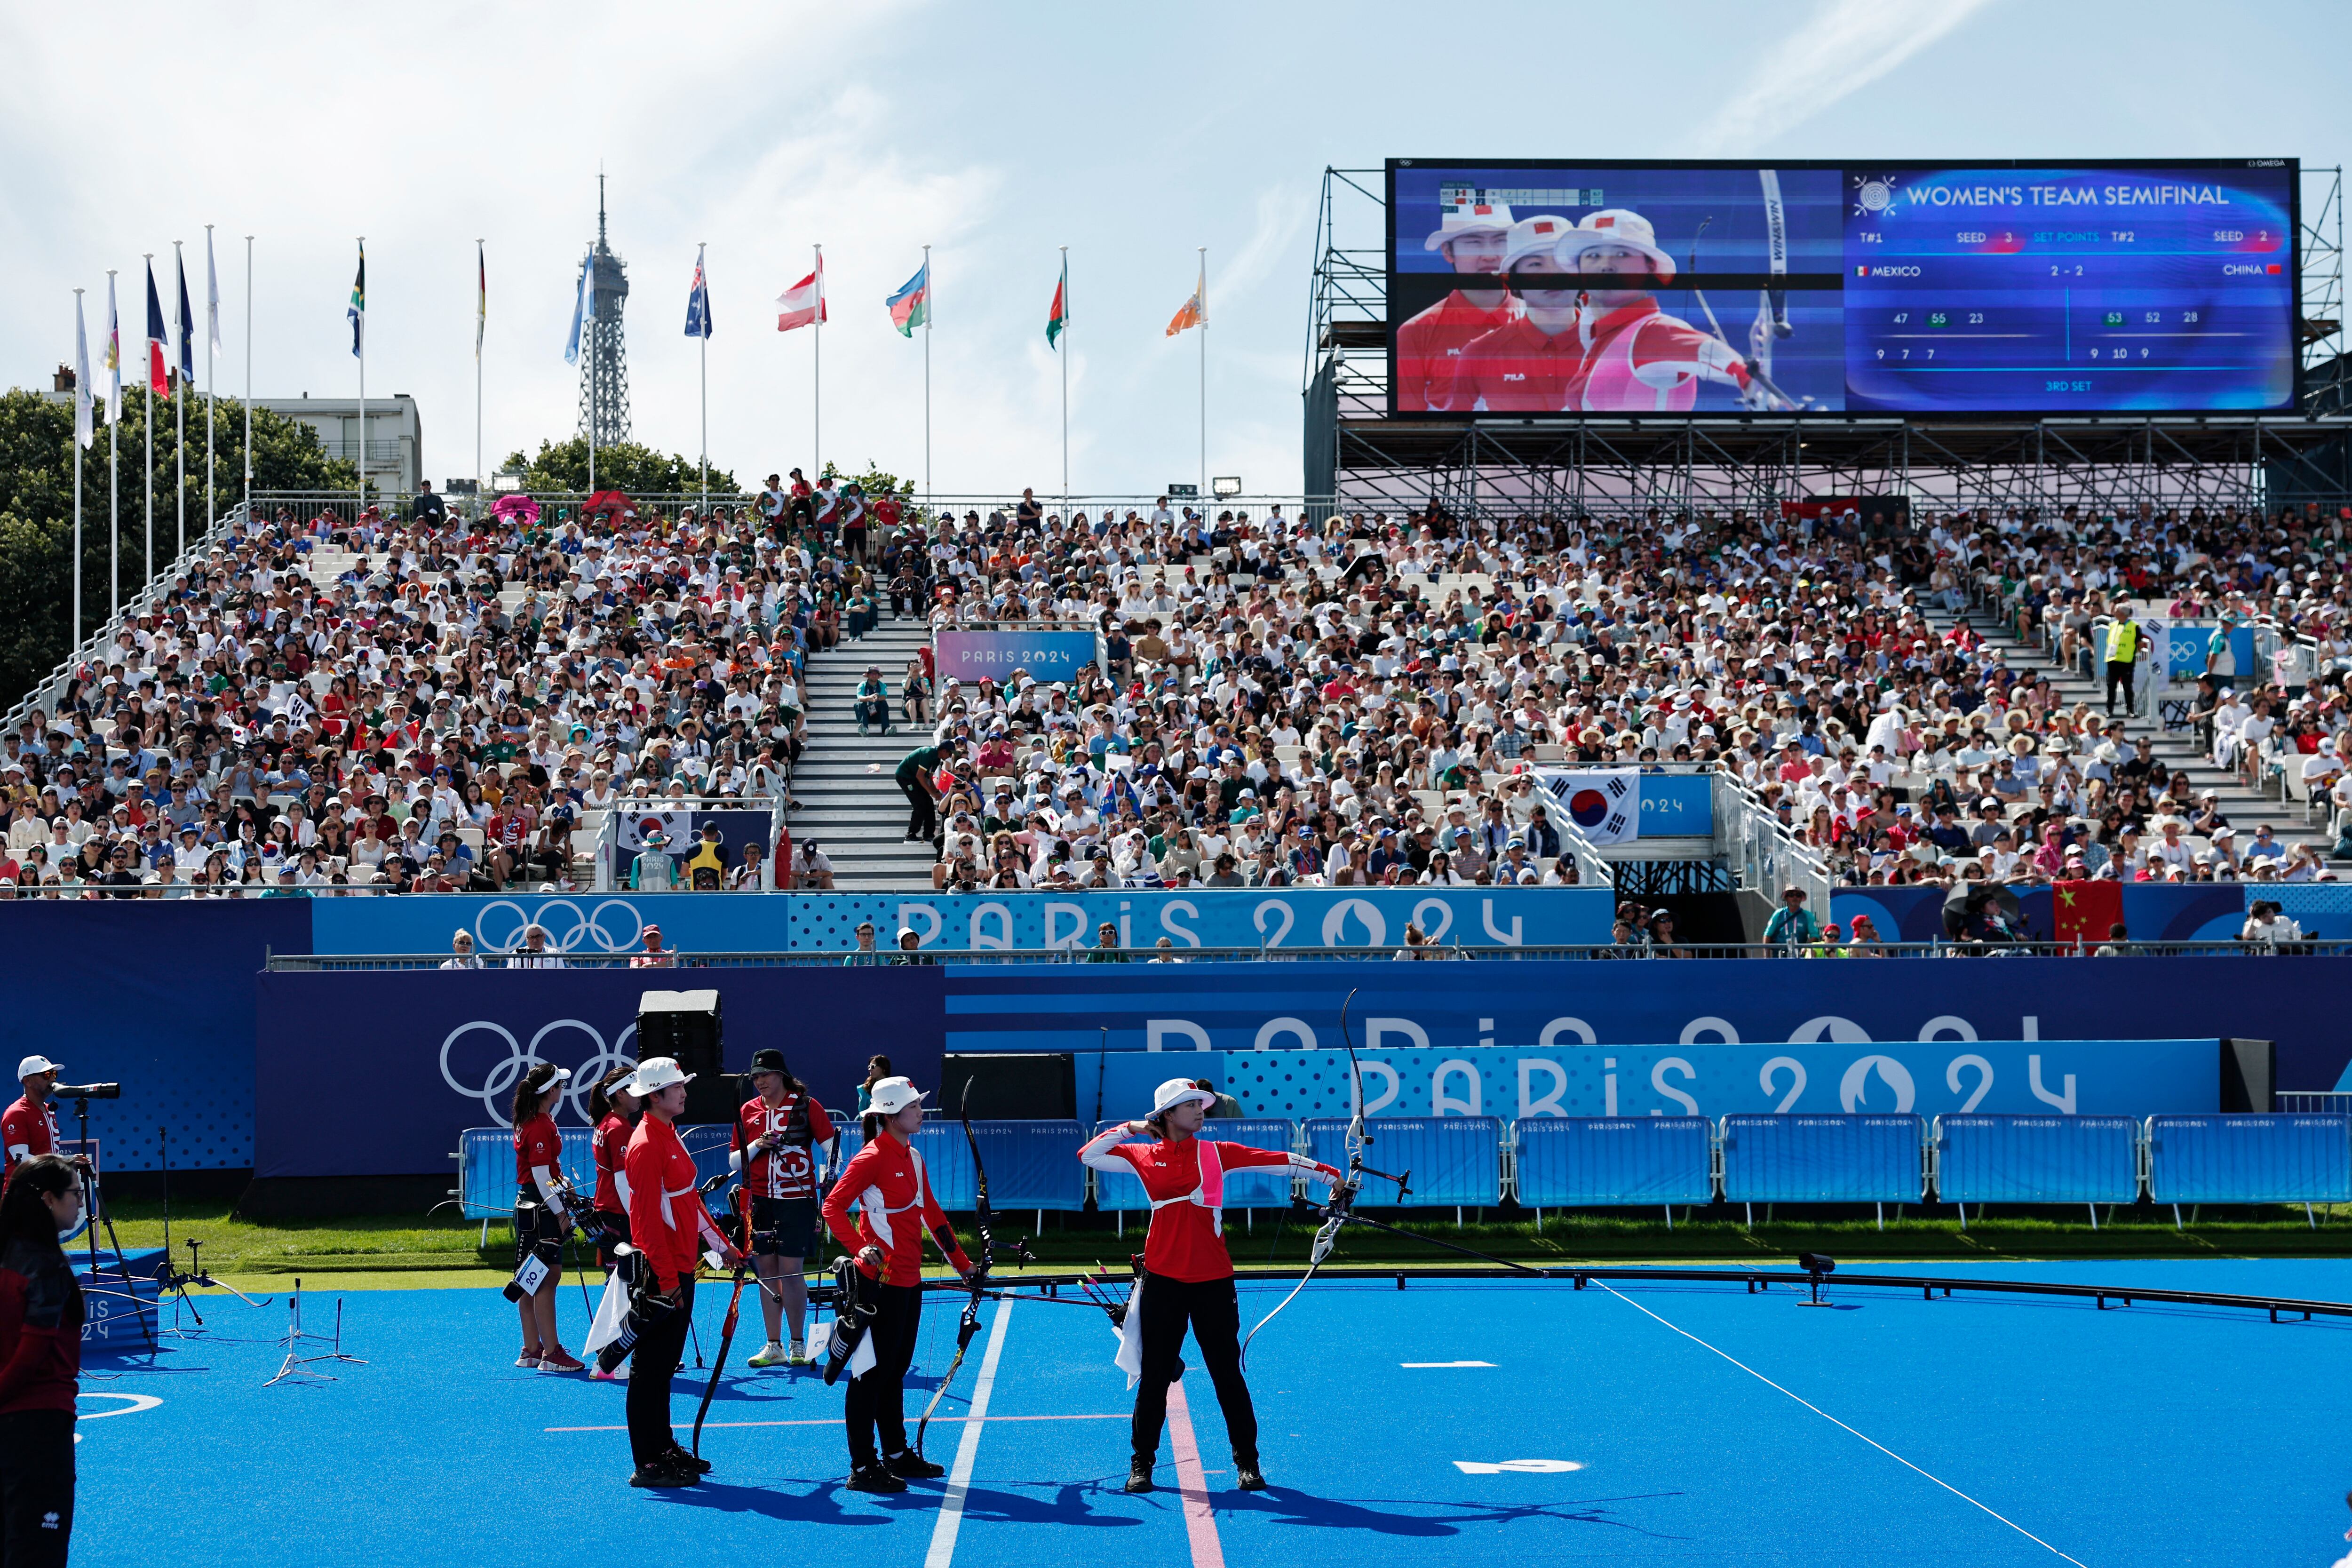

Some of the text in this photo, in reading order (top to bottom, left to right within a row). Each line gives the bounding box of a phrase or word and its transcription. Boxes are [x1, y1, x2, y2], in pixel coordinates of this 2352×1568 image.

[1907, 185, 2229, 206] WOMEN'S TEAM SEMIFINAL
[1769, 199, 1783, 261] WIN&WIN
[1860, 232, 1883, 243] T#1
[1956, 232, 2012, 243] SEED 3
[2033, 231, 2100, 242] SET POINTS
[2112, 231, 2135, 242] T#2
[2214, 231, 2268, 242] SEED 2
[1871, 266, 1921, 278] MEXICO
[2051, 266, 2058, 277] 2
[2075, 265, 2083, 277] 2
[2223, 264, 2263, 276] CHINA
[1894, 313, 1908, 324] 47
[1932, 313, 1946, 324] 55
[1969, 312, 1984, 324] 23
[2108, 312, 2122, 323] 53
[2146, 312, 2160, 323] 52
[2183, 312, 2198, 323] 28
[1876, 349, 1885, 359] 9
[1902, 349, 1909, 359] 7
[1927, 349, 1934, 359] 7
[2090, 348, 2098, 359] 9
[2113, 348, 2127, 359] 10
[2140, 348, 2149, 358] 9
[2046, 382, 2092, 392] 3RD SET
[1022, 651, 1069, 662] 2024
[1641, 799, 1683, 812] 024
[1253, 898, 1522, 947] 2024
[1760, 1055, 2074, 1115] 2024
[526, 1272, 537, 1287] 20
